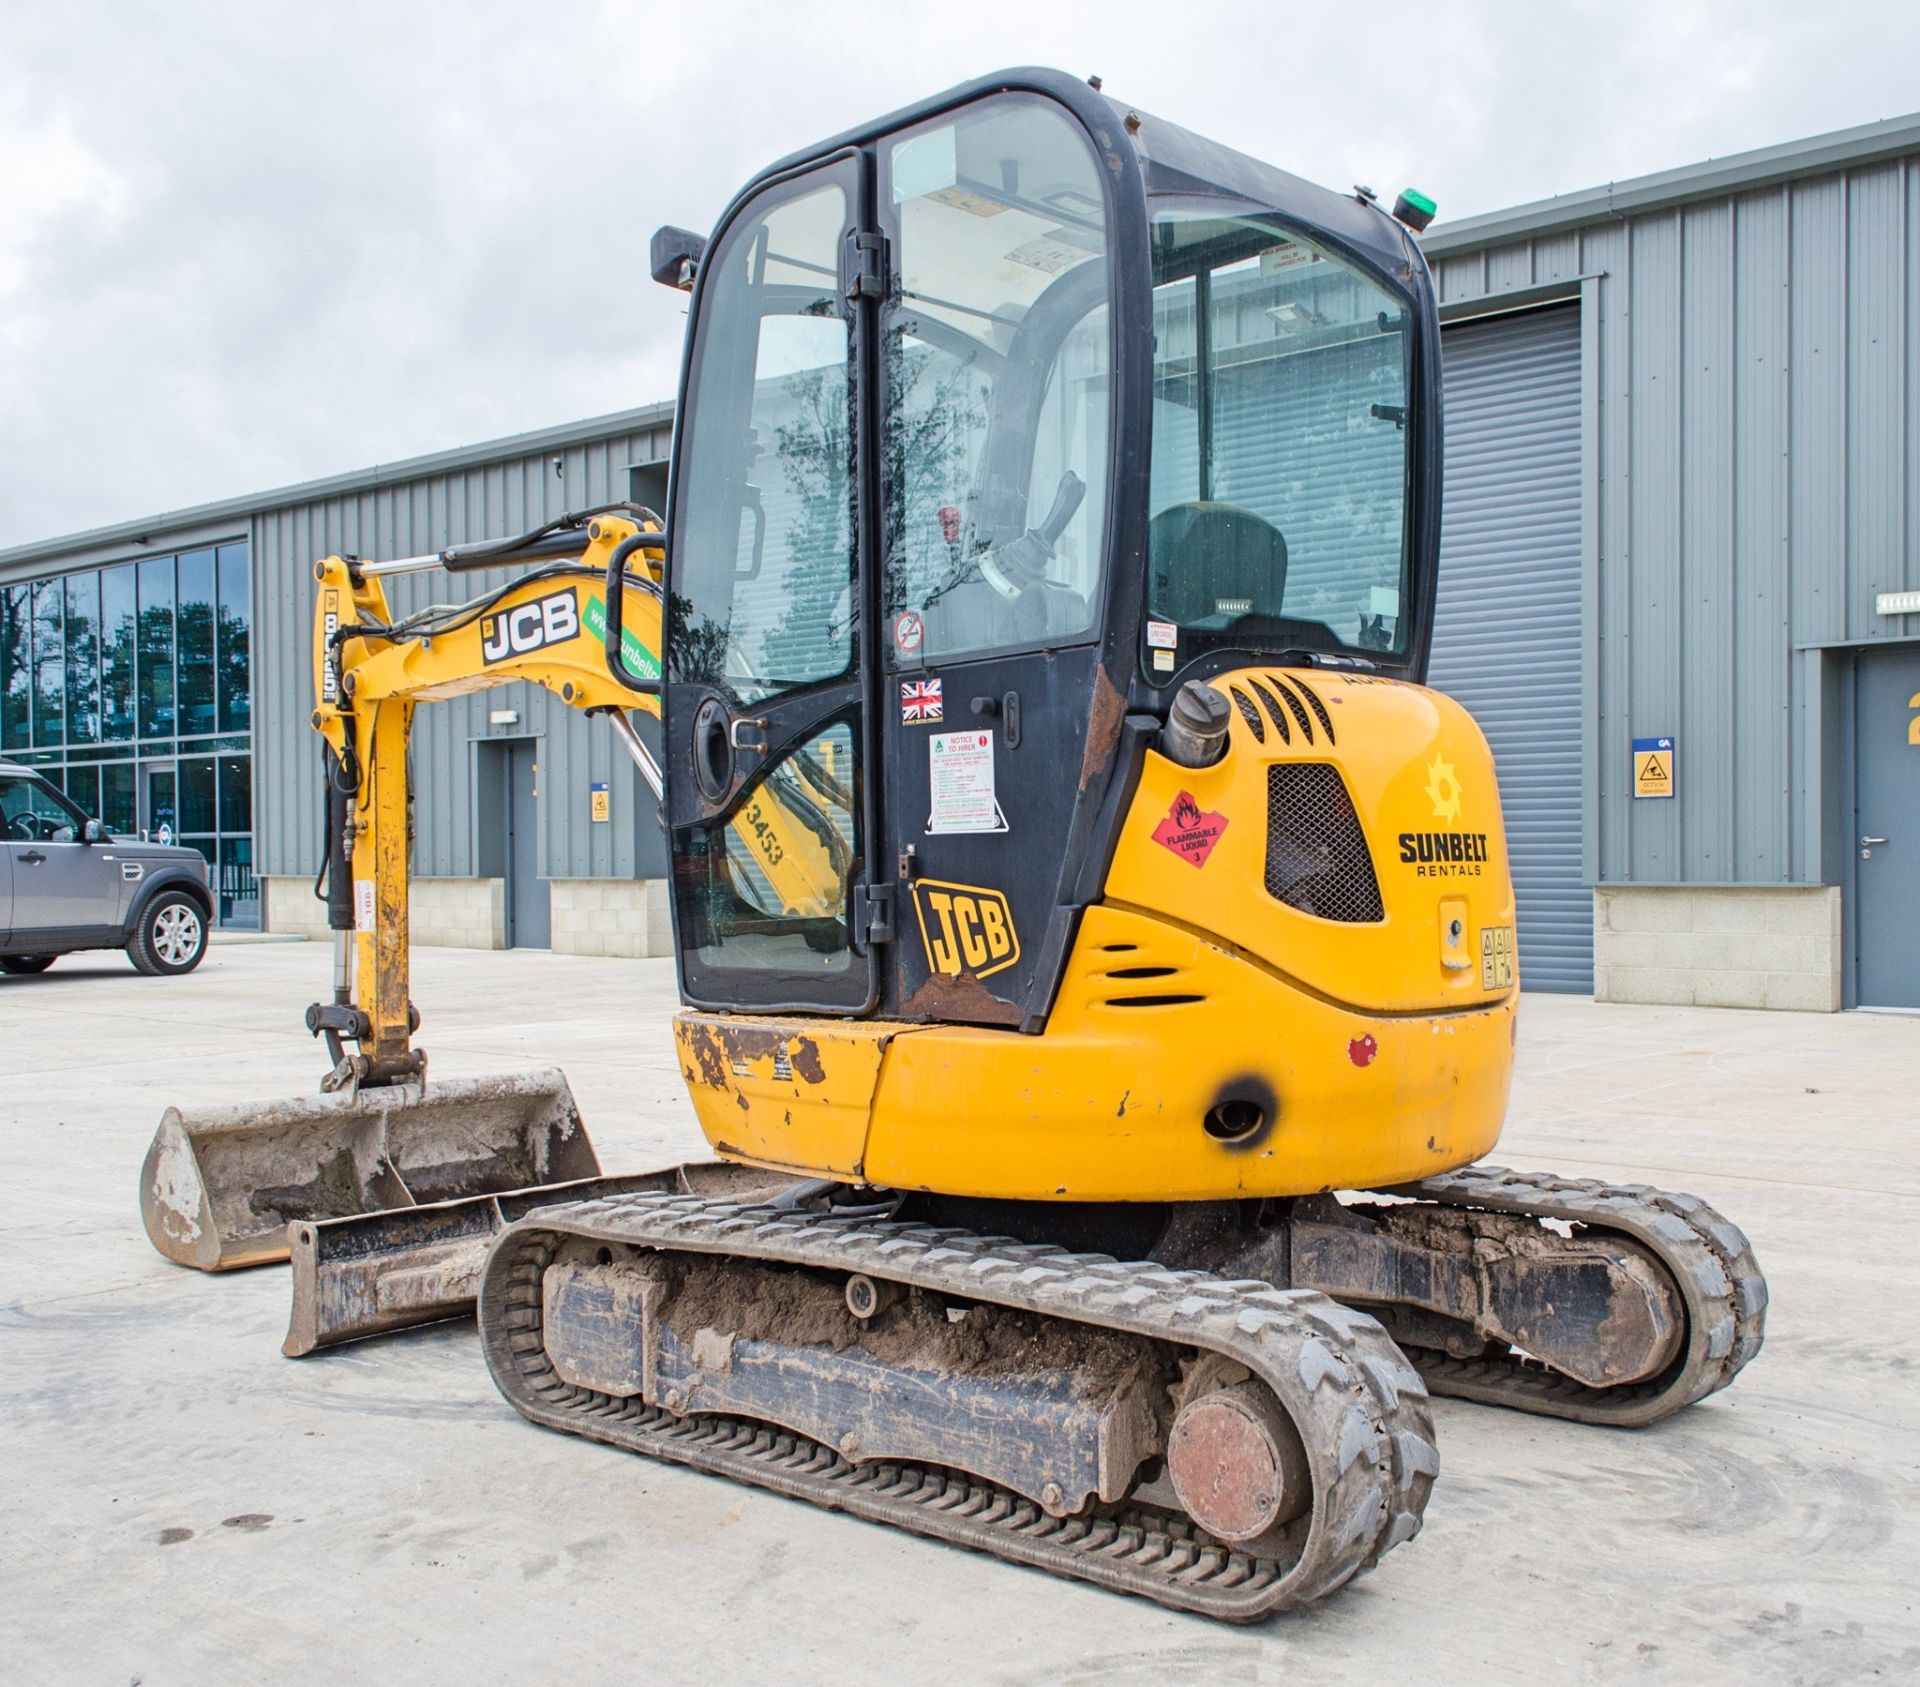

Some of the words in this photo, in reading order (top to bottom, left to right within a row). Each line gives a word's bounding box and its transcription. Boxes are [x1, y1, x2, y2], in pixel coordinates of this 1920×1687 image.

[483, 592, 578, 660] JCB
[950, 735, 973, 744] NOTICE
[1658, 739, 1671, 747] GA
[958, 744, 976, 752] HIRER
[1167, 827, 1217, 845] FLAMMABLE
[1182, 838, 1208, 851] LIQUID
[1398, 833, 1487, 863] SUNBELT
[1193, 853, 1201, 861] 3
[1416, 865, 1481, 877] RENTALS
[928, 891, 1010, 977] JCB
